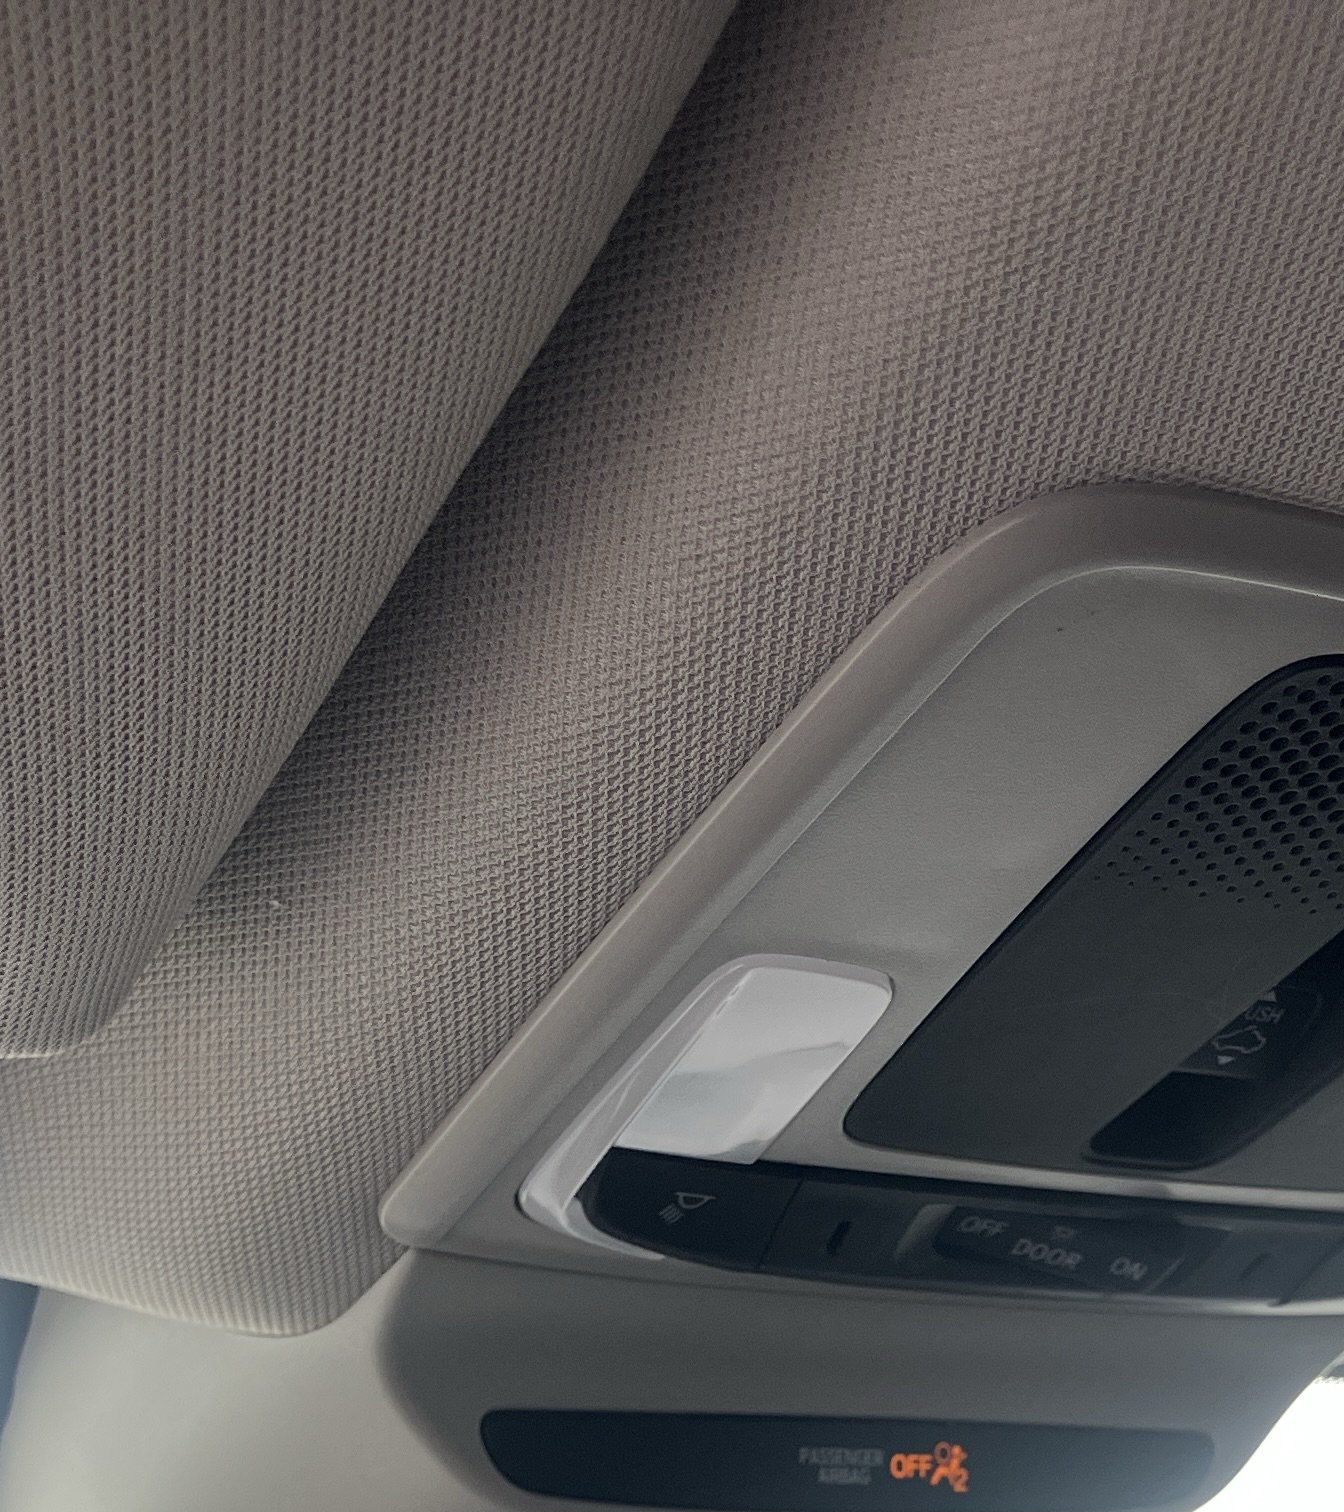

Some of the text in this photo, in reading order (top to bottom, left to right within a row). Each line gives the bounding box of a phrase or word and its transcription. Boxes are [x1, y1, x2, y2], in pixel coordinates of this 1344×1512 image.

[1244, 1005, 1286, 1024] USH
[958, 1215, 1008, 1236] OFF
[1010, 1237, 1082, 1269] DOOR
[1108, 1256, 1149, 1280] ON
[888, 1452, 933, 1480] OFF
